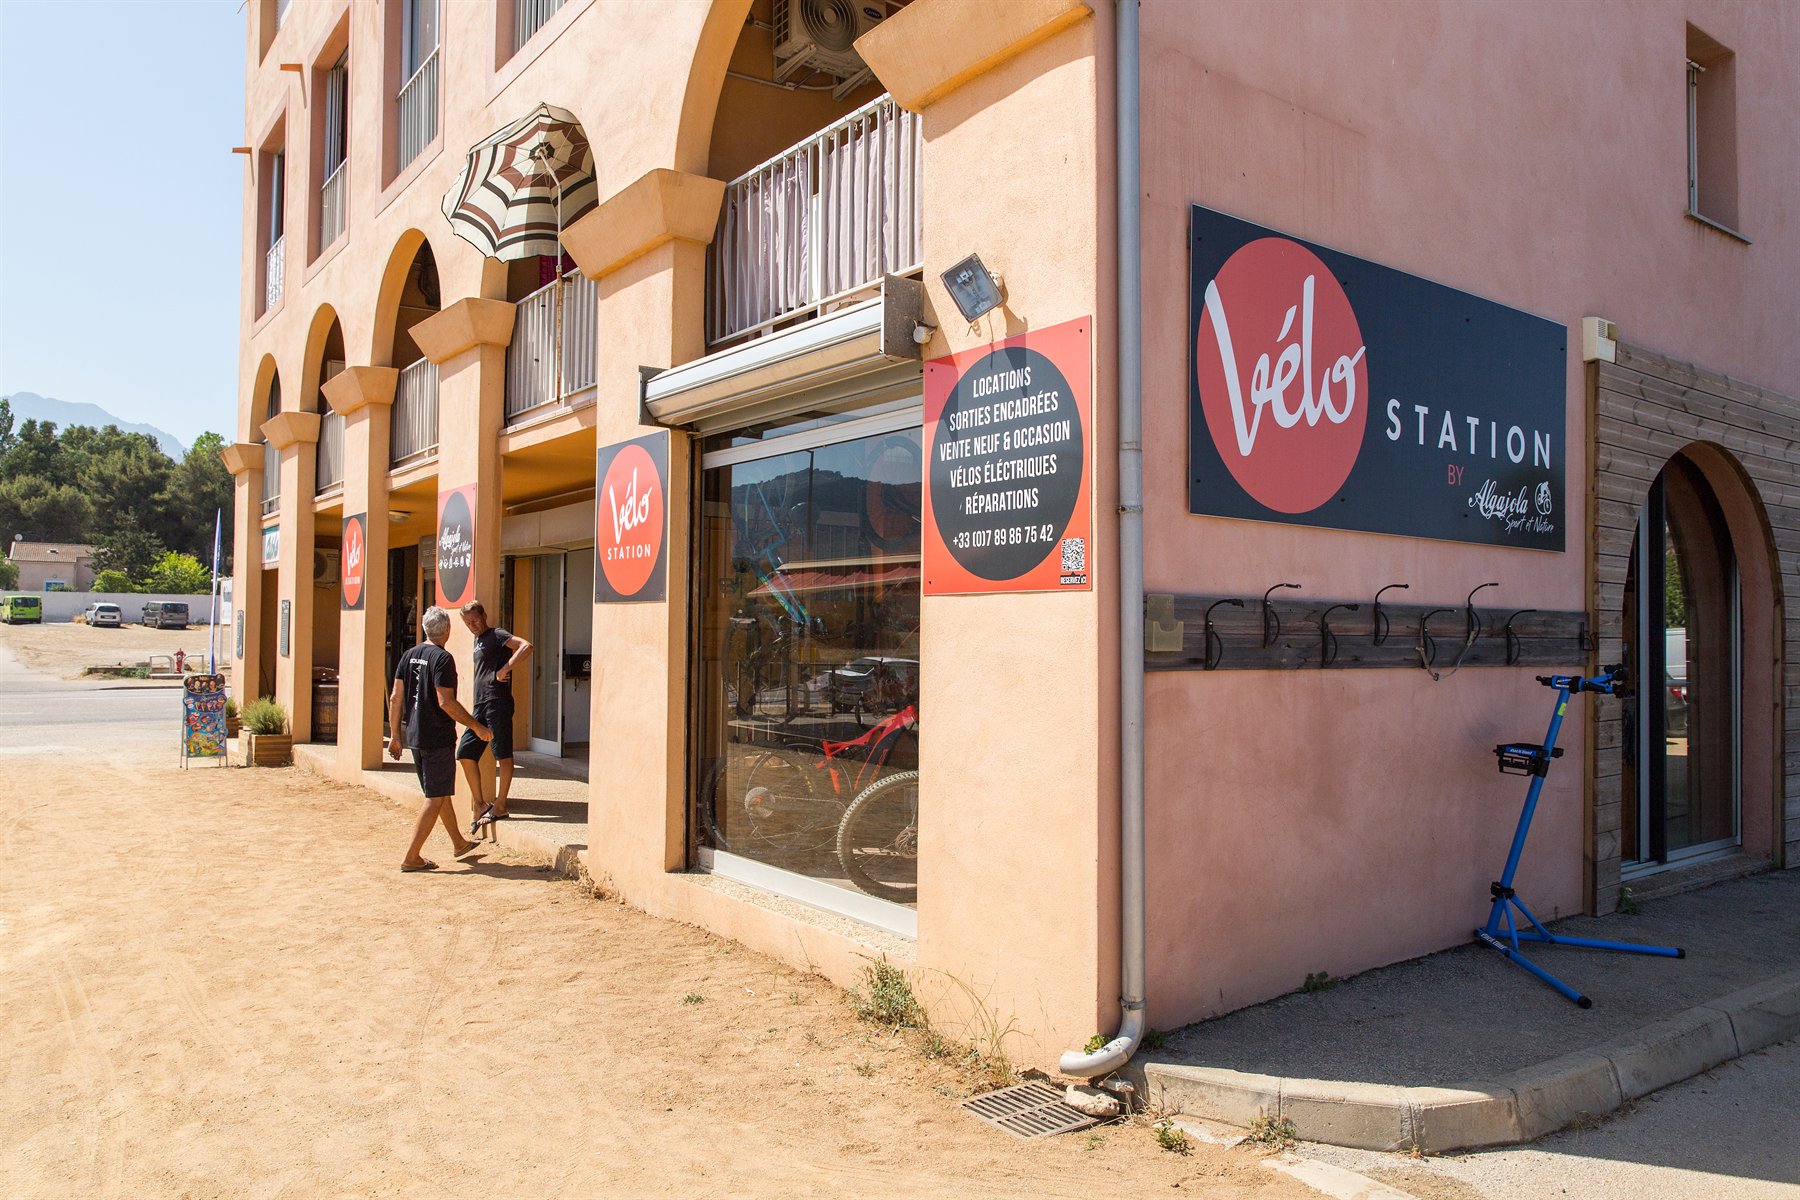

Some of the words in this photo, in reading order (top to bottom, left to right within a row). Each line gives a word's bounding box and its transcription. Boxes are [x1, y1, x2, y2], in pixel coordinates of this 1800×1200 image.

[973, 366, 1031, 398] LOCATIONS
[1204, 274, 1366, 457] Vélo
[949, 406, 990, 432] SORTIES
[994, 391, 1059, 423] ENCADRÉES
[940, 438, 970, 462] VENTE
[974, 433, 1000, 455] NEUF
[1003, 431, 1011, 451] &
[1014, 420, 1070, 449] OCCASION
[1385, 398, 1551, 470] STATION
[950, 465, 982, 488] VÉLOS
[984, 454, 1057, 484] ÉLÉCTRIQUES
[1447, 464, 1464, 486] BY
[609, 466, 653, 545] Vélo
[965, 487, 1039, 515] RÉPARATIONS
[1468, 479, 1528, 520] Algajola
[953, 530, 970, 549] +33
[972, 529, 992, 548] (0)7
[994, 527, 1006, 546] 89
[1009, 526, 1022, 545] 86
[1025, 525, 1037, 543] 75
[1040, 524, 1053, 542] 42
[1505, 513, 1526, 535] Sport
[1525, 516, 1534, 532] et
[608, 543, 651, 561] STATION
